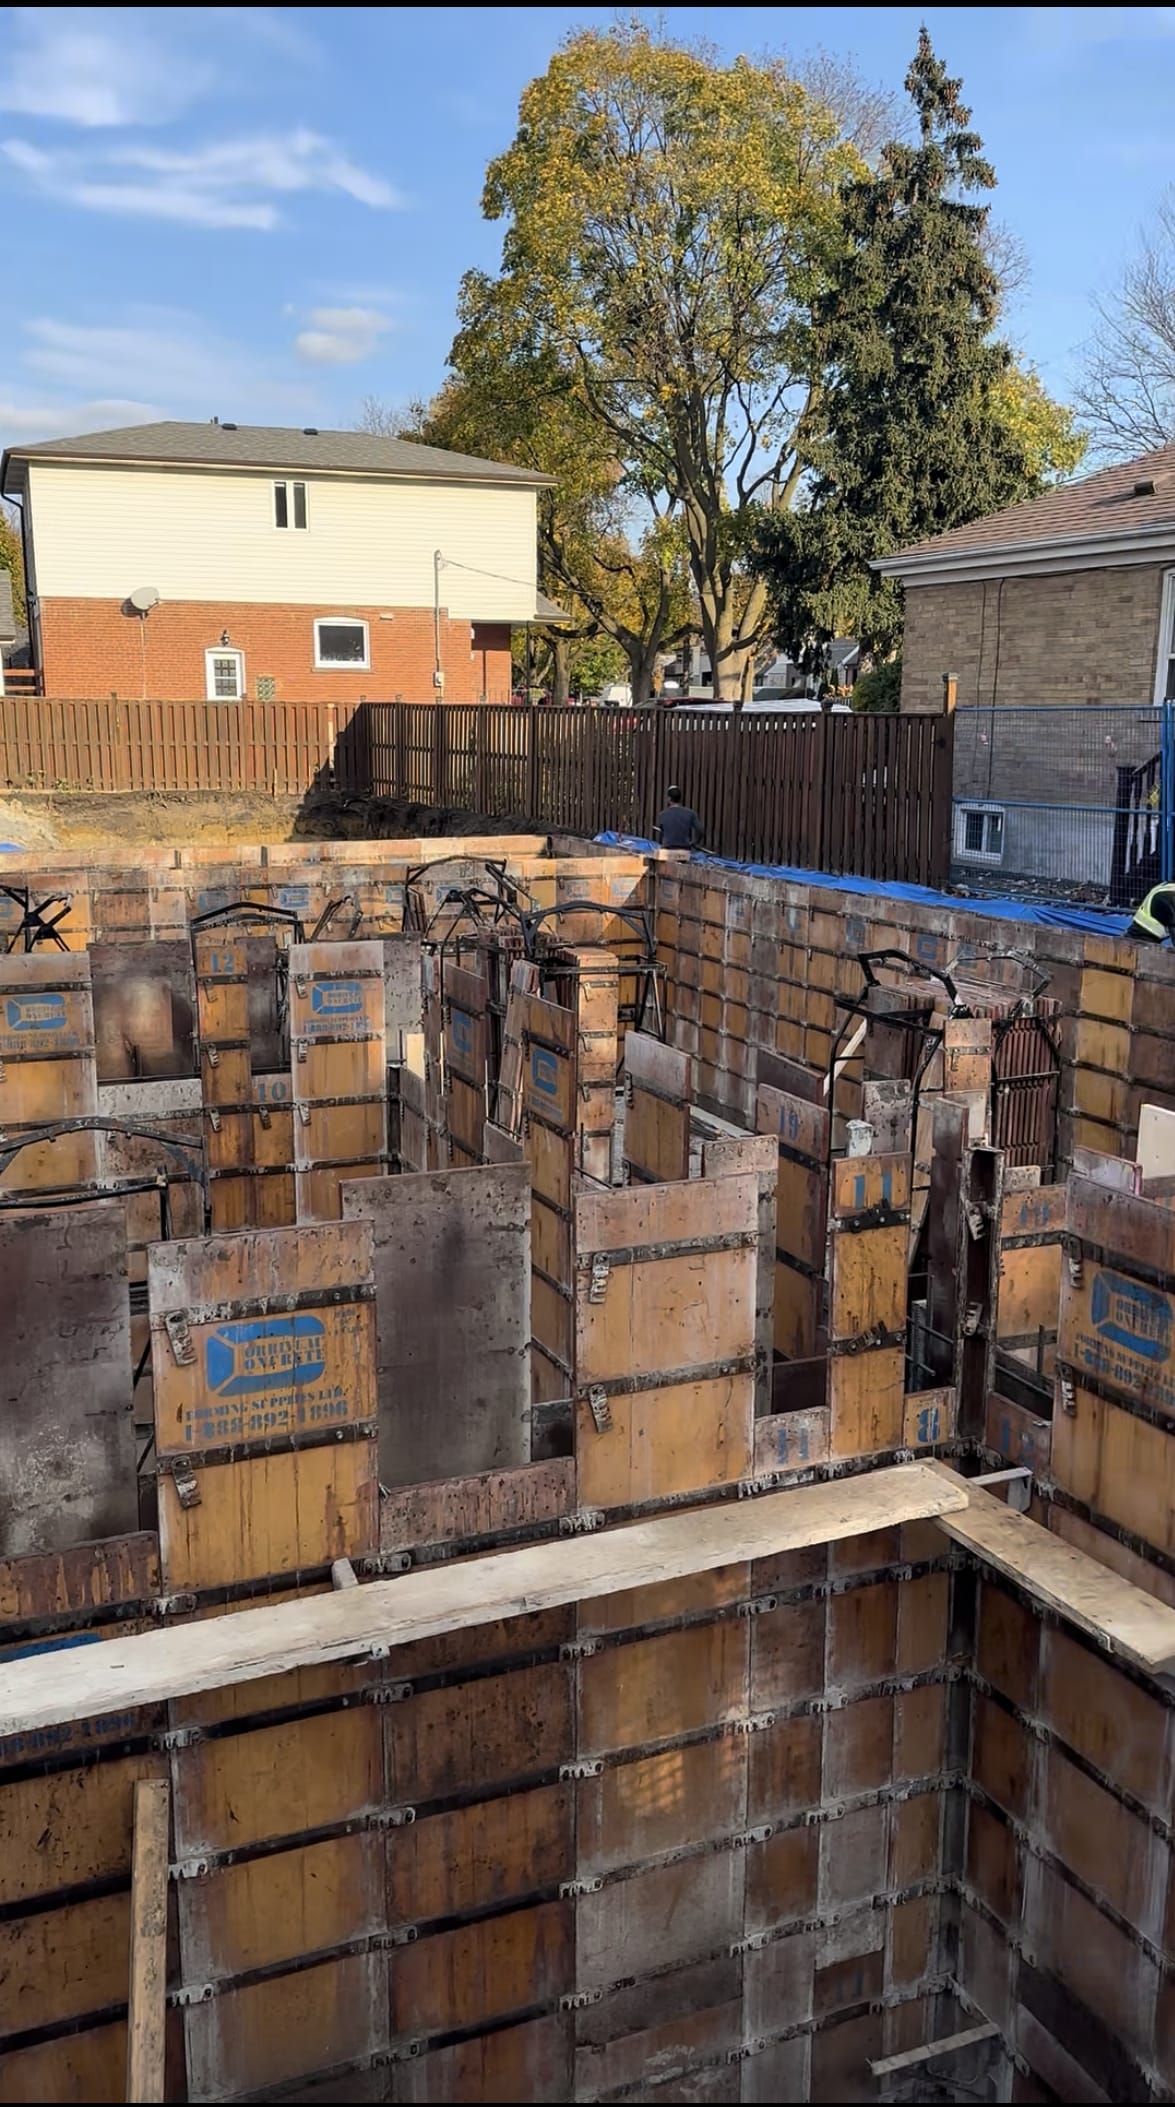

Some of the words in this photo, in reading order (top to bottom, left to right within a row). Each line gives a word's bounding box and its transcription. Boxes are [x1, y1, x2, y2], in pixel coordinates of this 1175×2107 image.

[211, 952, 235, 974] 12
[258, 1081, 287, 1103] 10
[779, 1105, 800, 1142] 19
[855, 1170, 892, 1209] 11
[917, 1407, 941, 1443] 8
